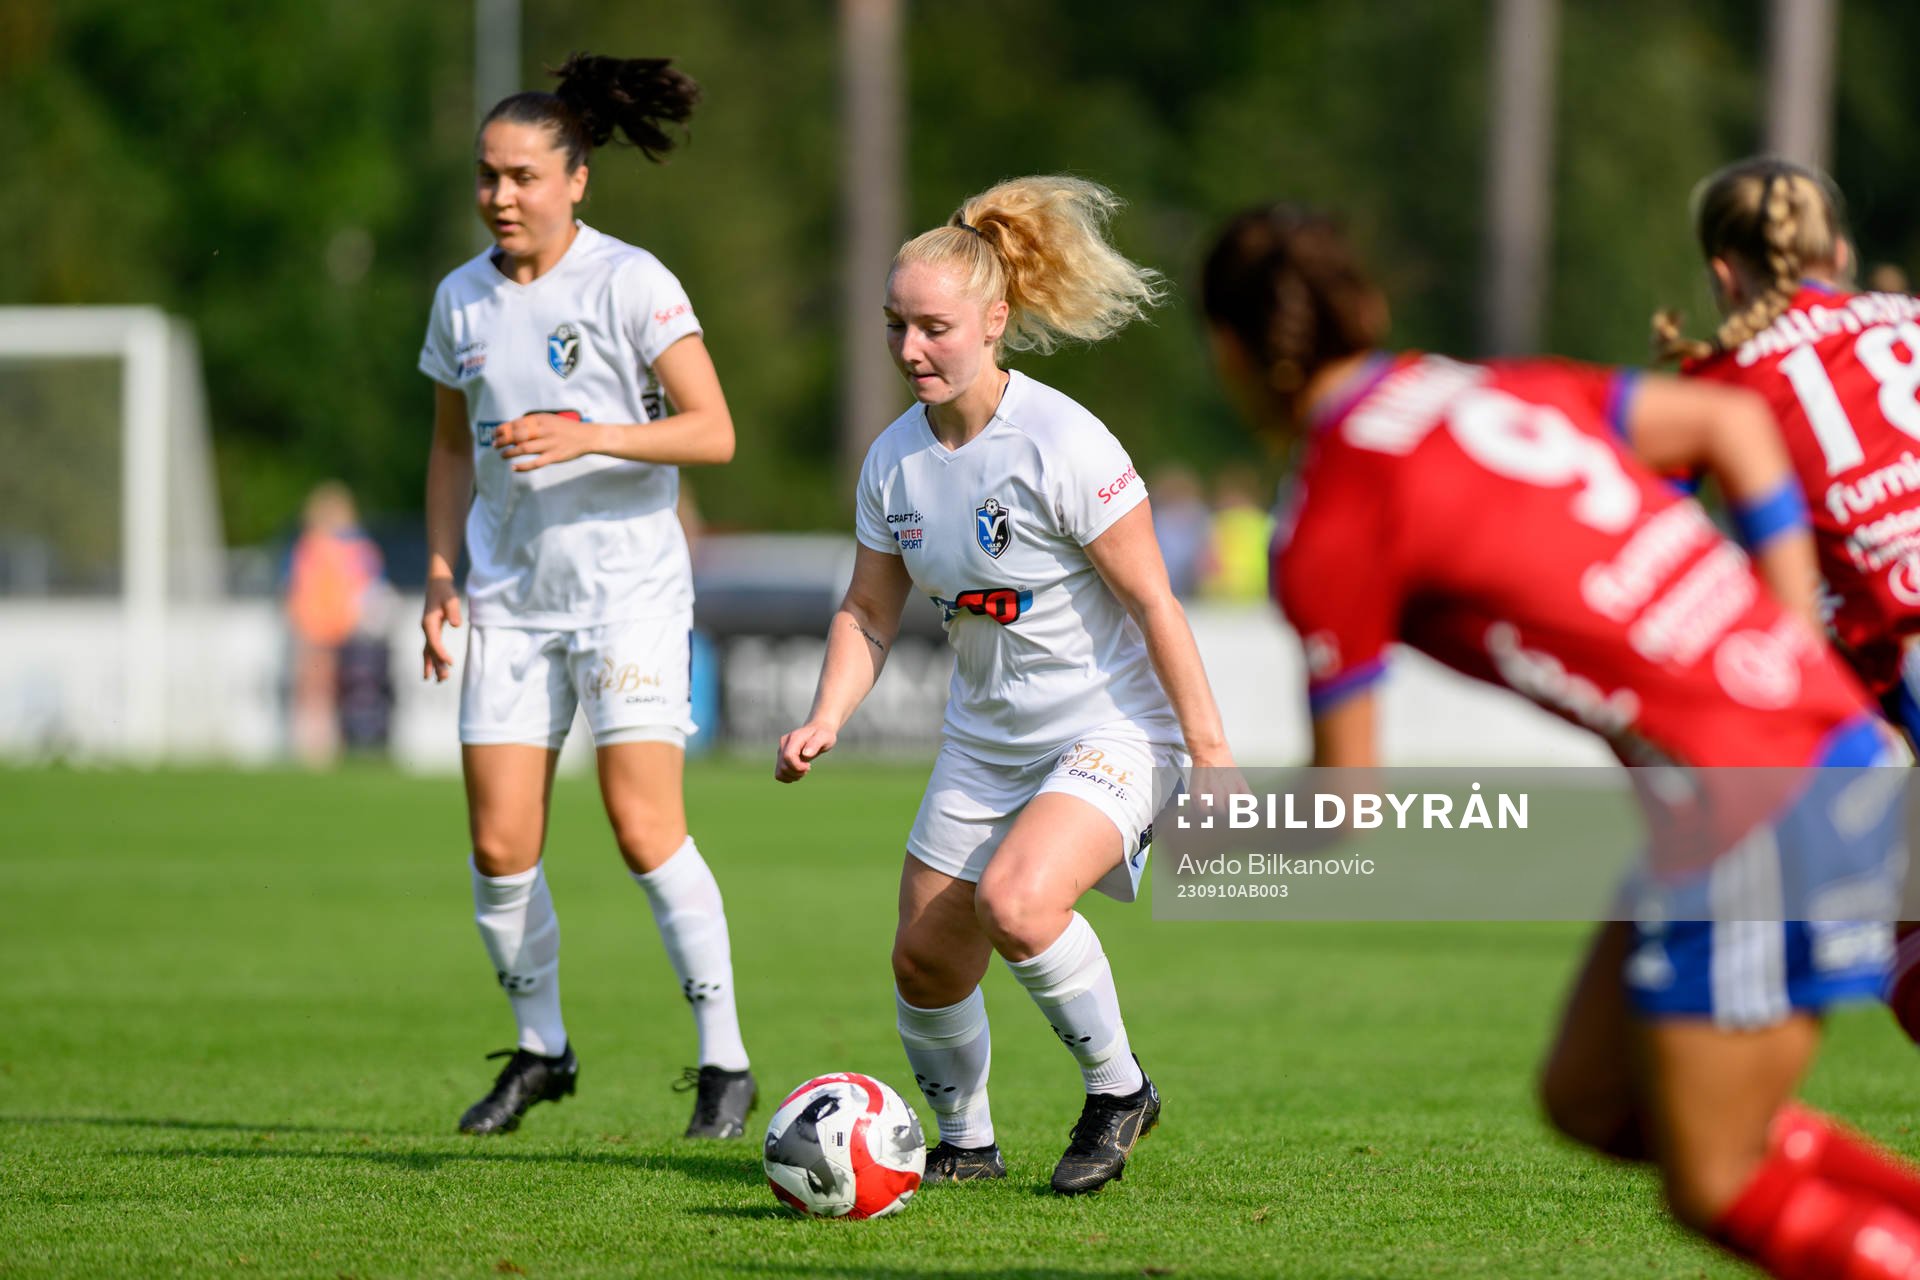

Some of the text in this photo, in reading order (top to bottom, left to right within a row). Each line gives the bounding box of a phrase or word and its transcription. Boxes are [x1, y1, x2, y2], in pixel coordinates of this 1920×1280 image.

[1445, 386, 1642, 535] 9
[887, 513, 914, 523] CRAFT
[900, 529, 922, 539] INTER
[901, 539, 923, 549] SPORT
[1068, 769, 1116, 790] CRAFT
